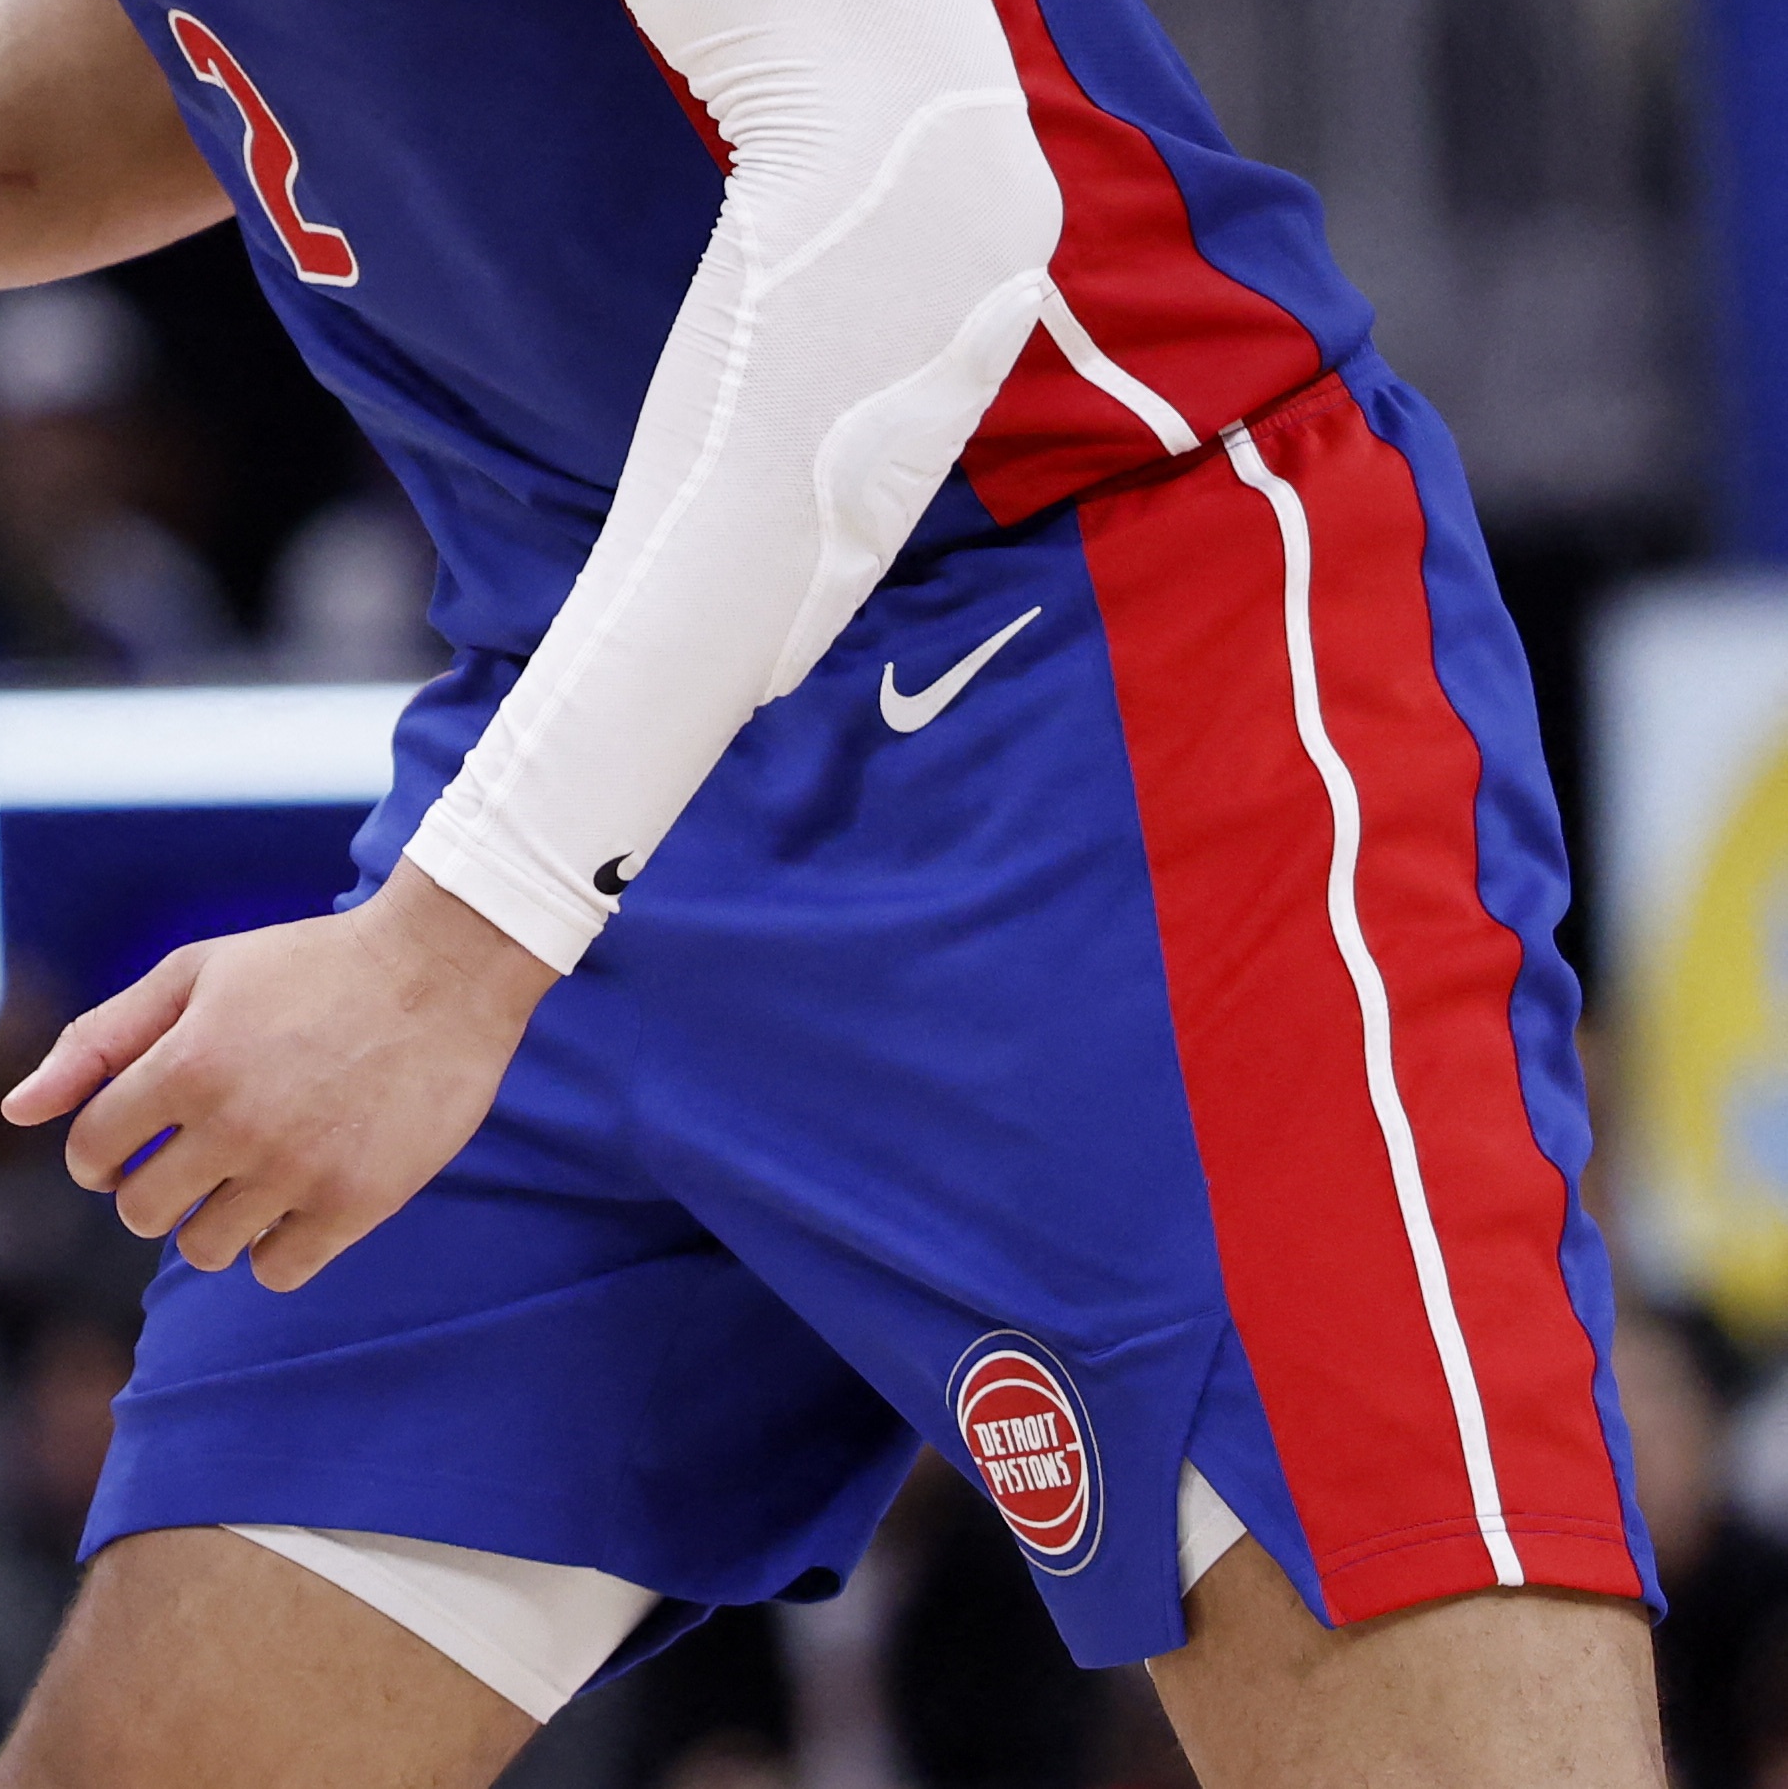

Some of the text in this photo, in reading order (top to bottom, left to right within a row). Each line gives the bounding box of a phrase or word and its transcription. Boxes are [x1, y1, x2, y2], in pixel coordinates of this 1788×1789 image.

[169, 9, 359, 288] 2
[973, 1412, 1059, 1457] DETROIT
[985, 1451, 1072, 1495] PISTONS
